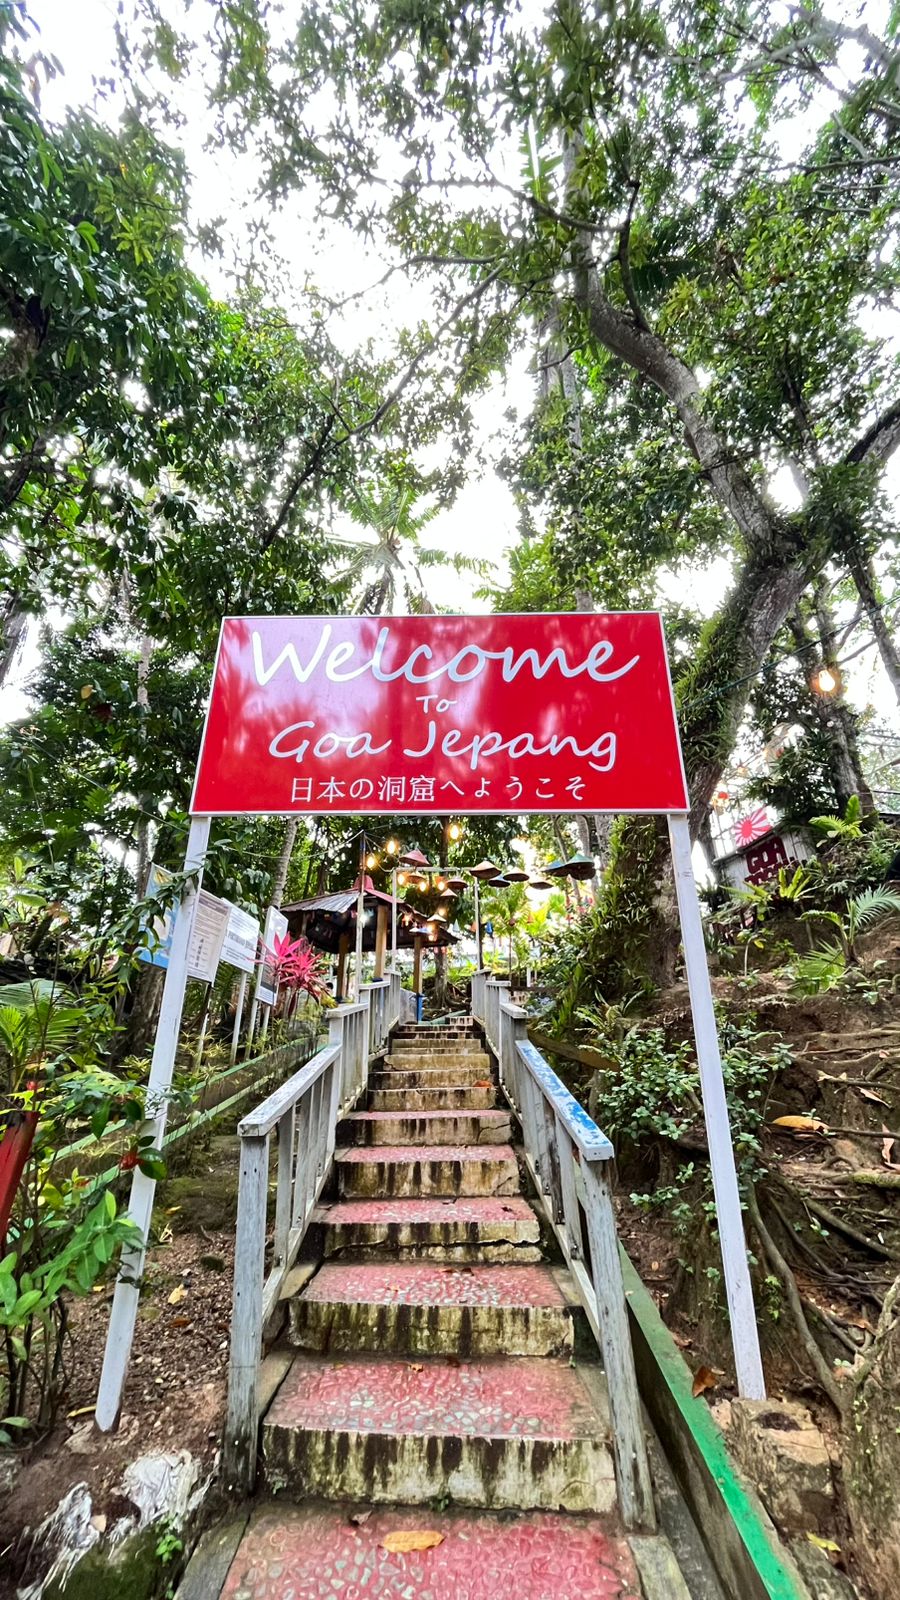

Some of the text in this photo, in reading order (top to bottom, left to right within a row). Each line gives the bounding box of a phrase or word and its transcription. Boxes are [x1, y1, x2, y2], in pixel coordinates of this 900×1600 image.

[252, 624, 640, 686] Welcome
[416, 694, 458, 714] To
[268, 720, 617, 773] Goa Jepang
[290, 775, 587, 803] 日本の洞窟へようこそ
